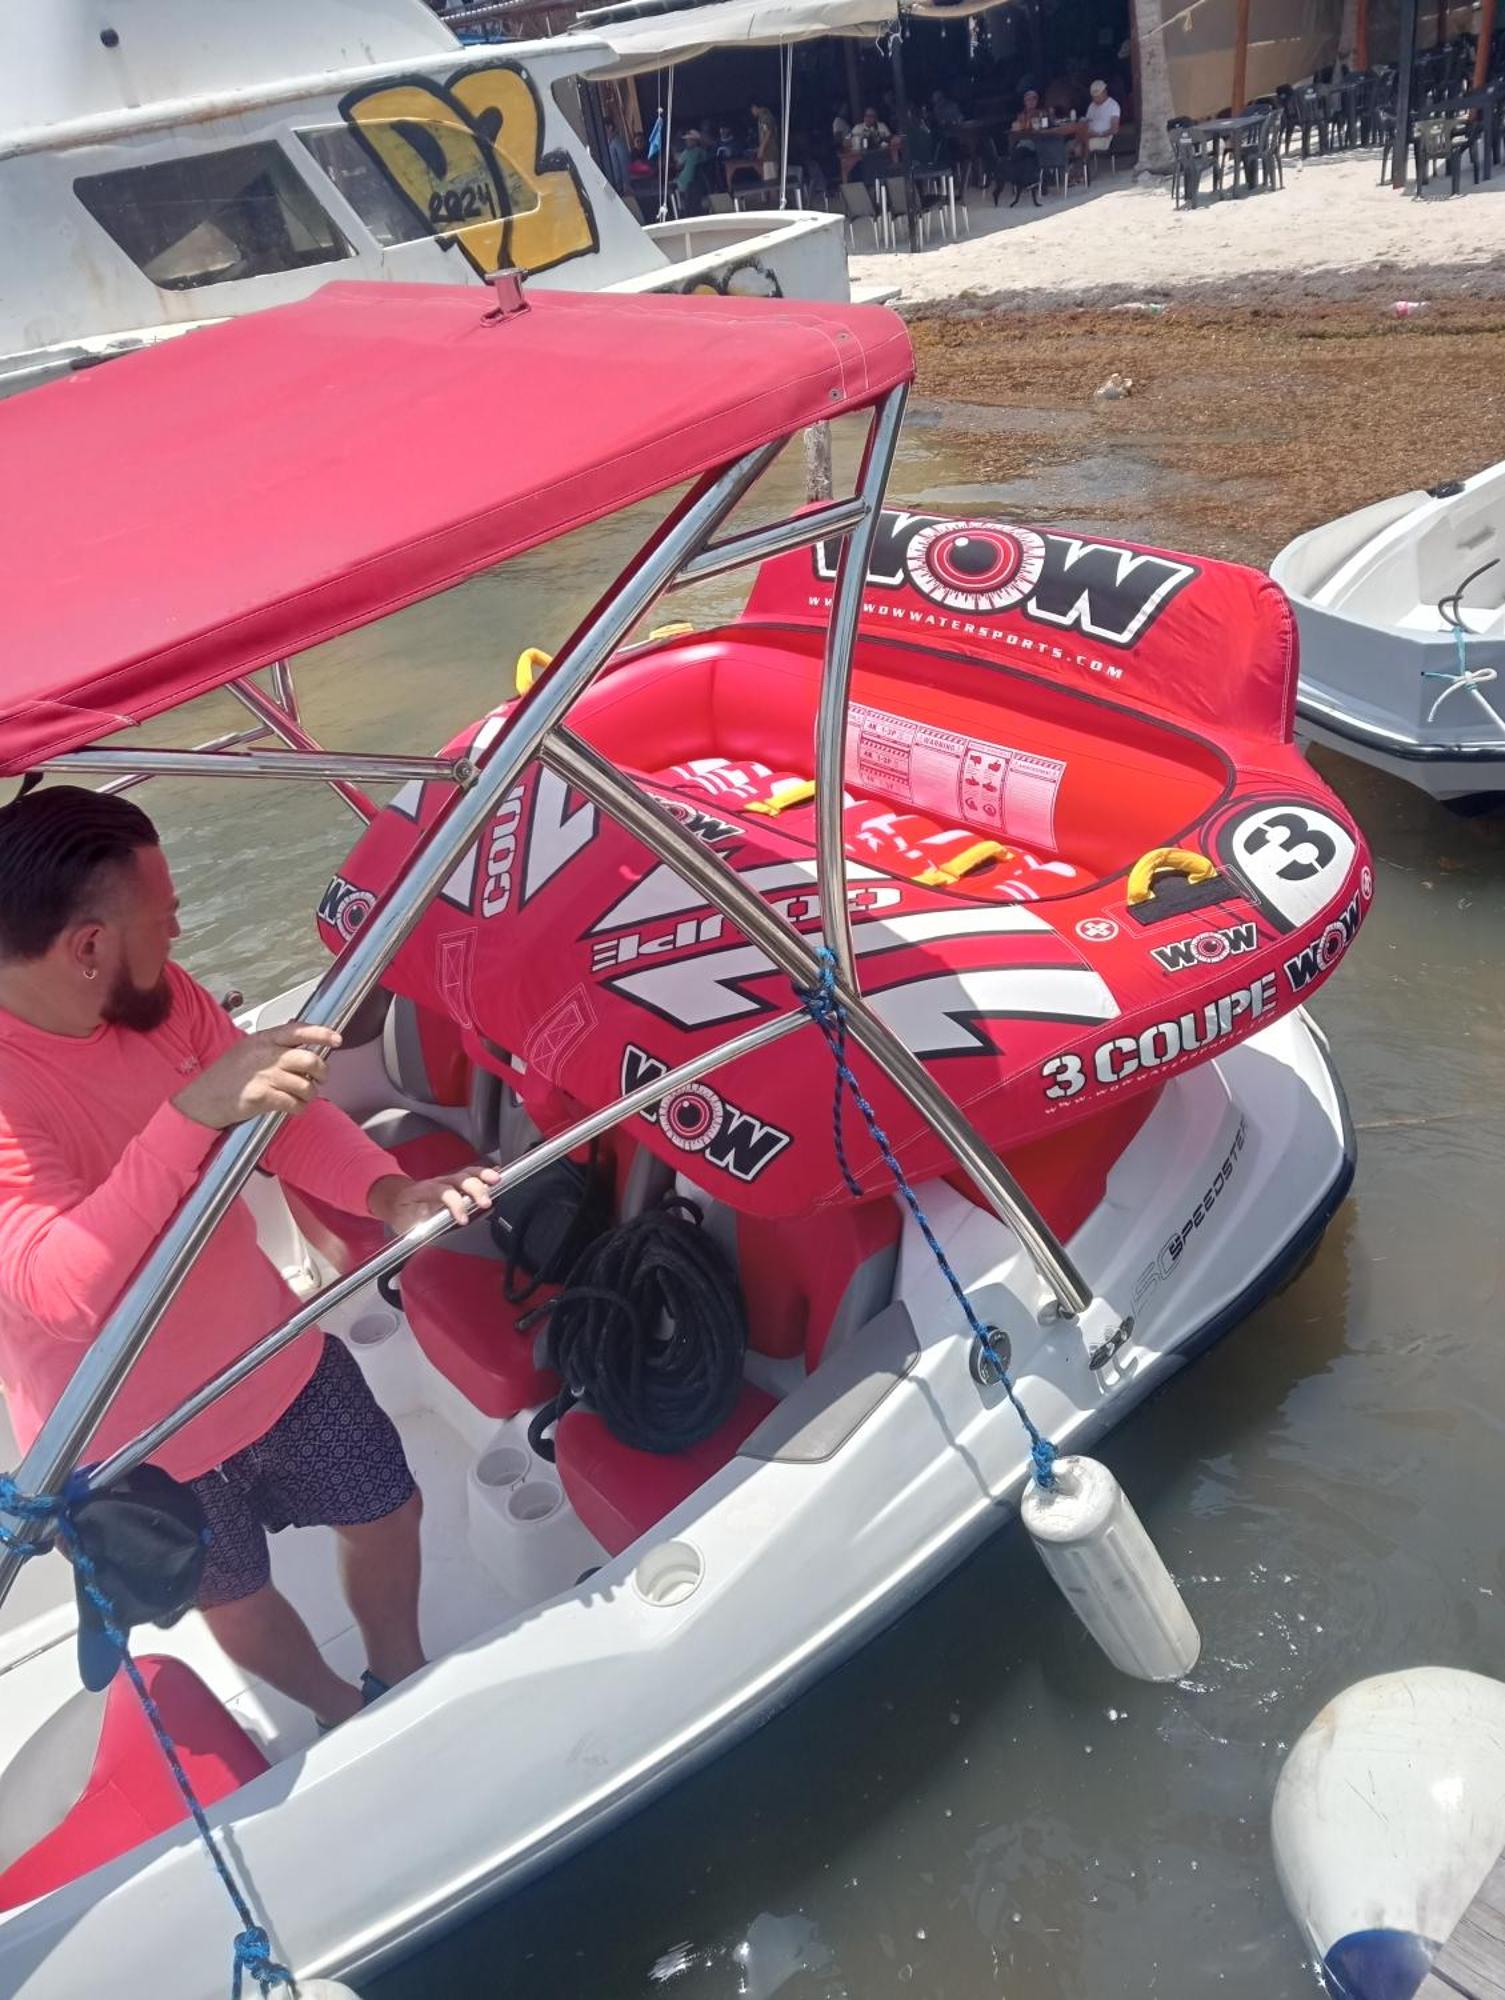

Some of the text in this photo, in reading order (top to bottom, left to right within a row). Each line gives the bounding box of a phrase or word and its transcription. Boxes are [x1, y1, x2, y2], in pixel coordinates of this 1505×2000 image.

[428, 183, 499, 223] 2024
[811, 508, 1204, 650] WOW
[808, 596, 1125, 681] WWWOWWATERSPORTS.COM
[481, 785, 526, 919] COU
[646, 791, 746, 843] OW
[1242, 812, 1337, 882] 3
[316, 875, 378, 942] WO
[1149, 921, 1258, 973] WOW
[1283, 890, 1363, 993] WOW
[1041, 971, 1279, 1100] 3 COUPE
[620, 1043, 793, 1184] WOW
